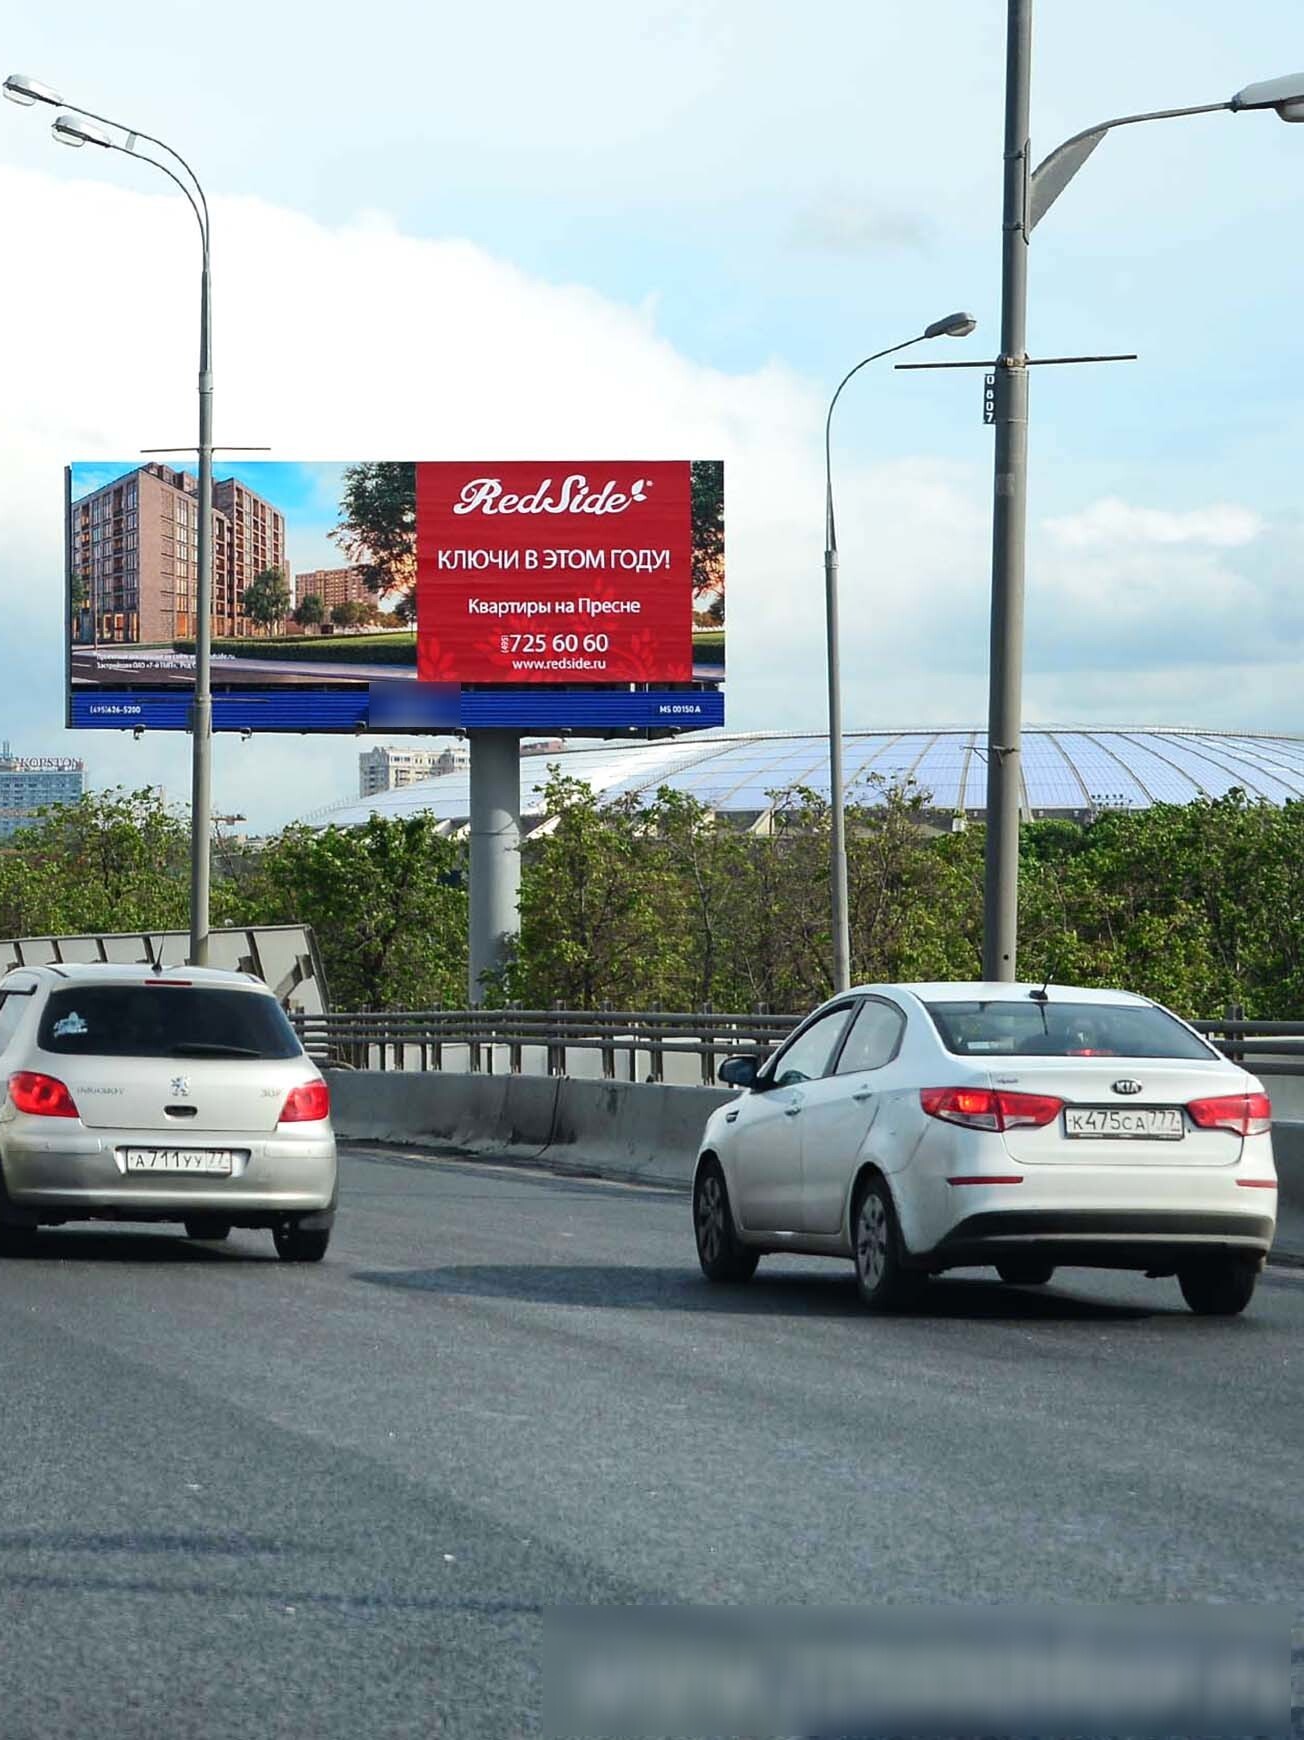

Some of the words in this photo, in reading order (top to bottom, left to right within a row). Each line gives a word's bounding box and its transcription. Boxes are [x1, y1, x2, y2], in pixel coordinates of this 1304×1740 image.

[985, 374, 996, 424] 0607
[453, 475, 633, 514] RedSide
[437, 549, 519, 570] КЛЮЧИ
[525, 550, 539, 569] В
[543, 549, 605, 570] ЭТОМ
[611, 549, 671, 573] ГОДУ!
[468, 598, 551, 616] Квартиры
[556, 601, 574, 614] на
[578, 598, 641, 616] Пресне
[510, 634, 546, 652] 725
[552, 634, 578, 652] 60
[583, 634, 609, 652] 60
[512, 658, 607, 670] www.redside.ru
[1116, 1081, 1140, 1093] KIA
